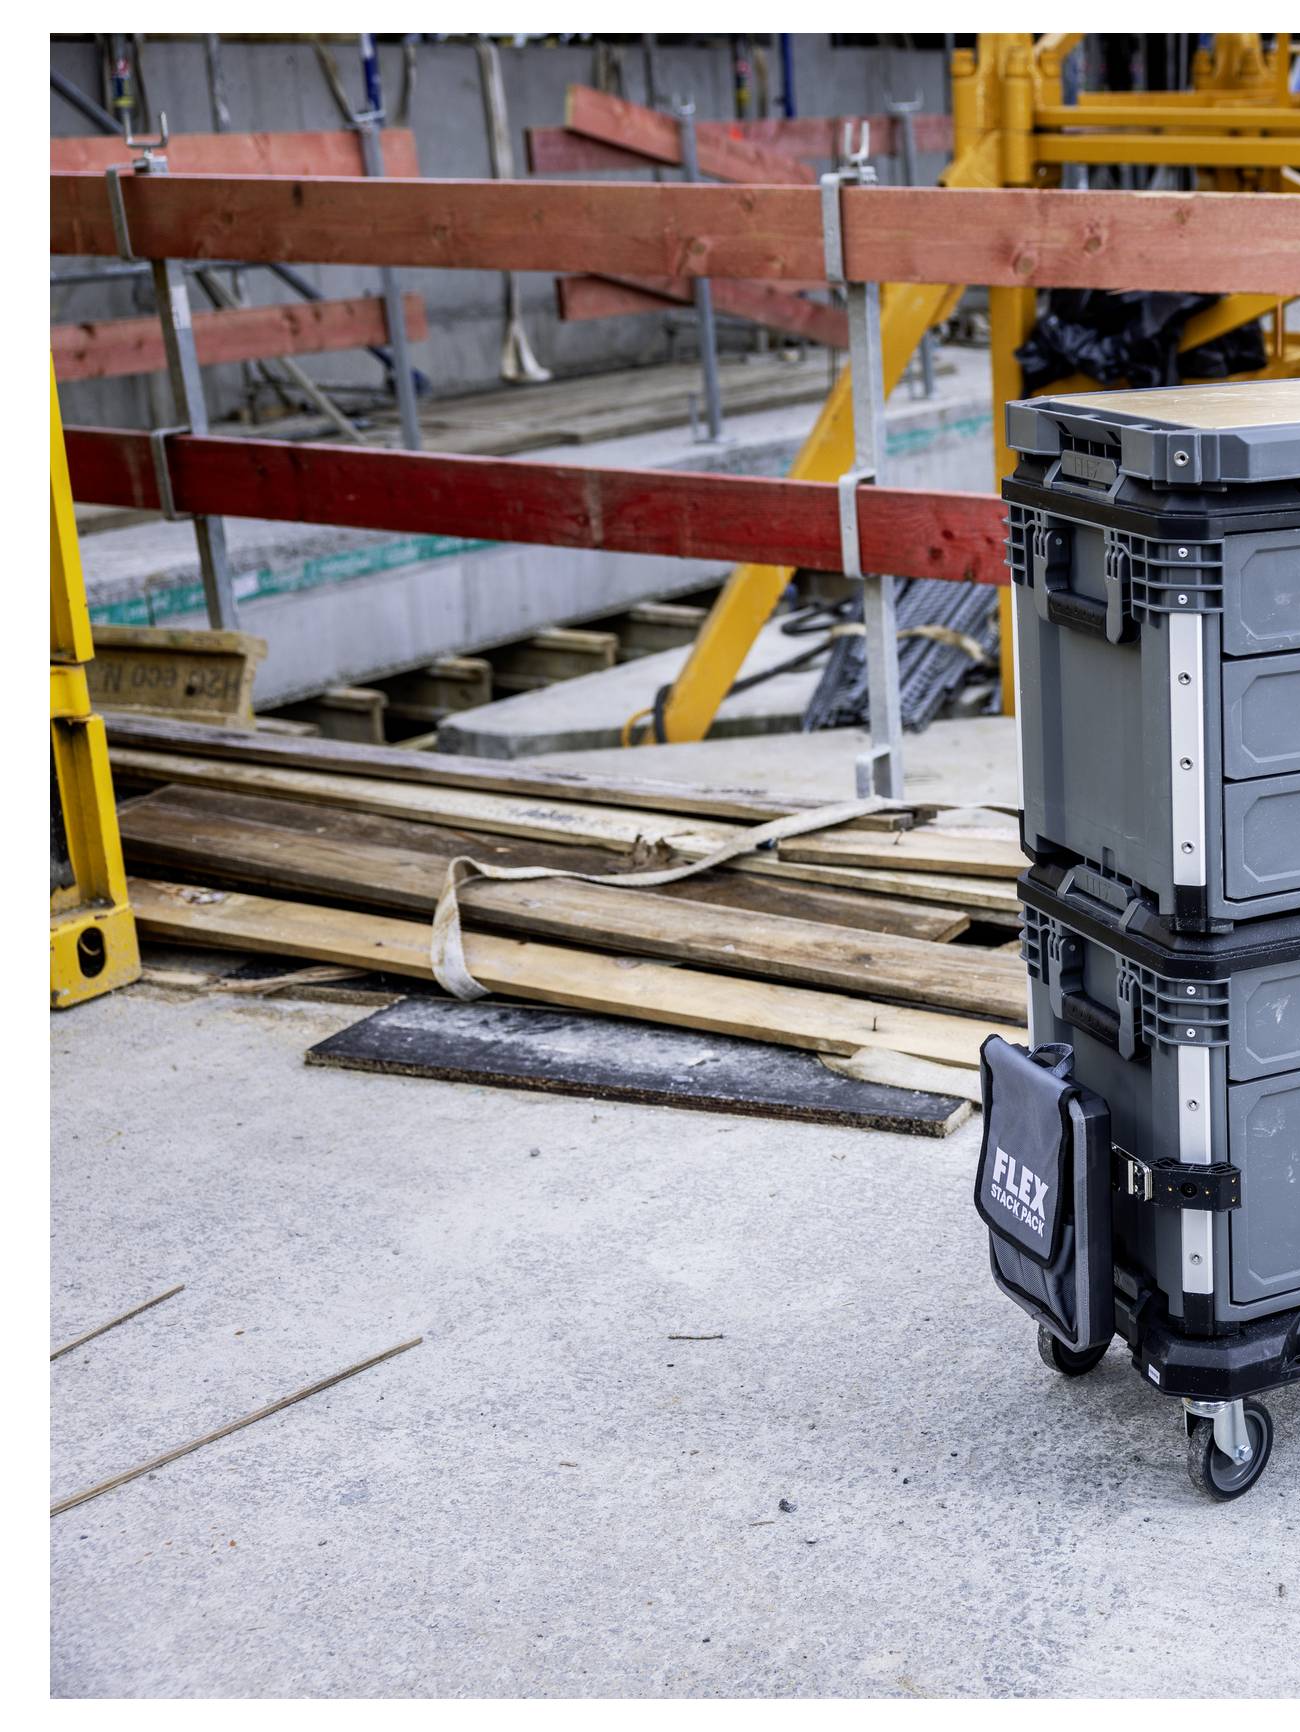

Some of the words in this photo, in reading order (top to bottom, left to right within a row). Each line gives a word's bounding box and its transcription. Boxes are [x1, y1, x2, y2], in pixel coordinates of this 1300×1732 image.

[990, 1183, 1021, 1216] STACK
[1020, 1206, 1045, 1237] PACK
[992, 1146, 1049, 1221] FLEX
